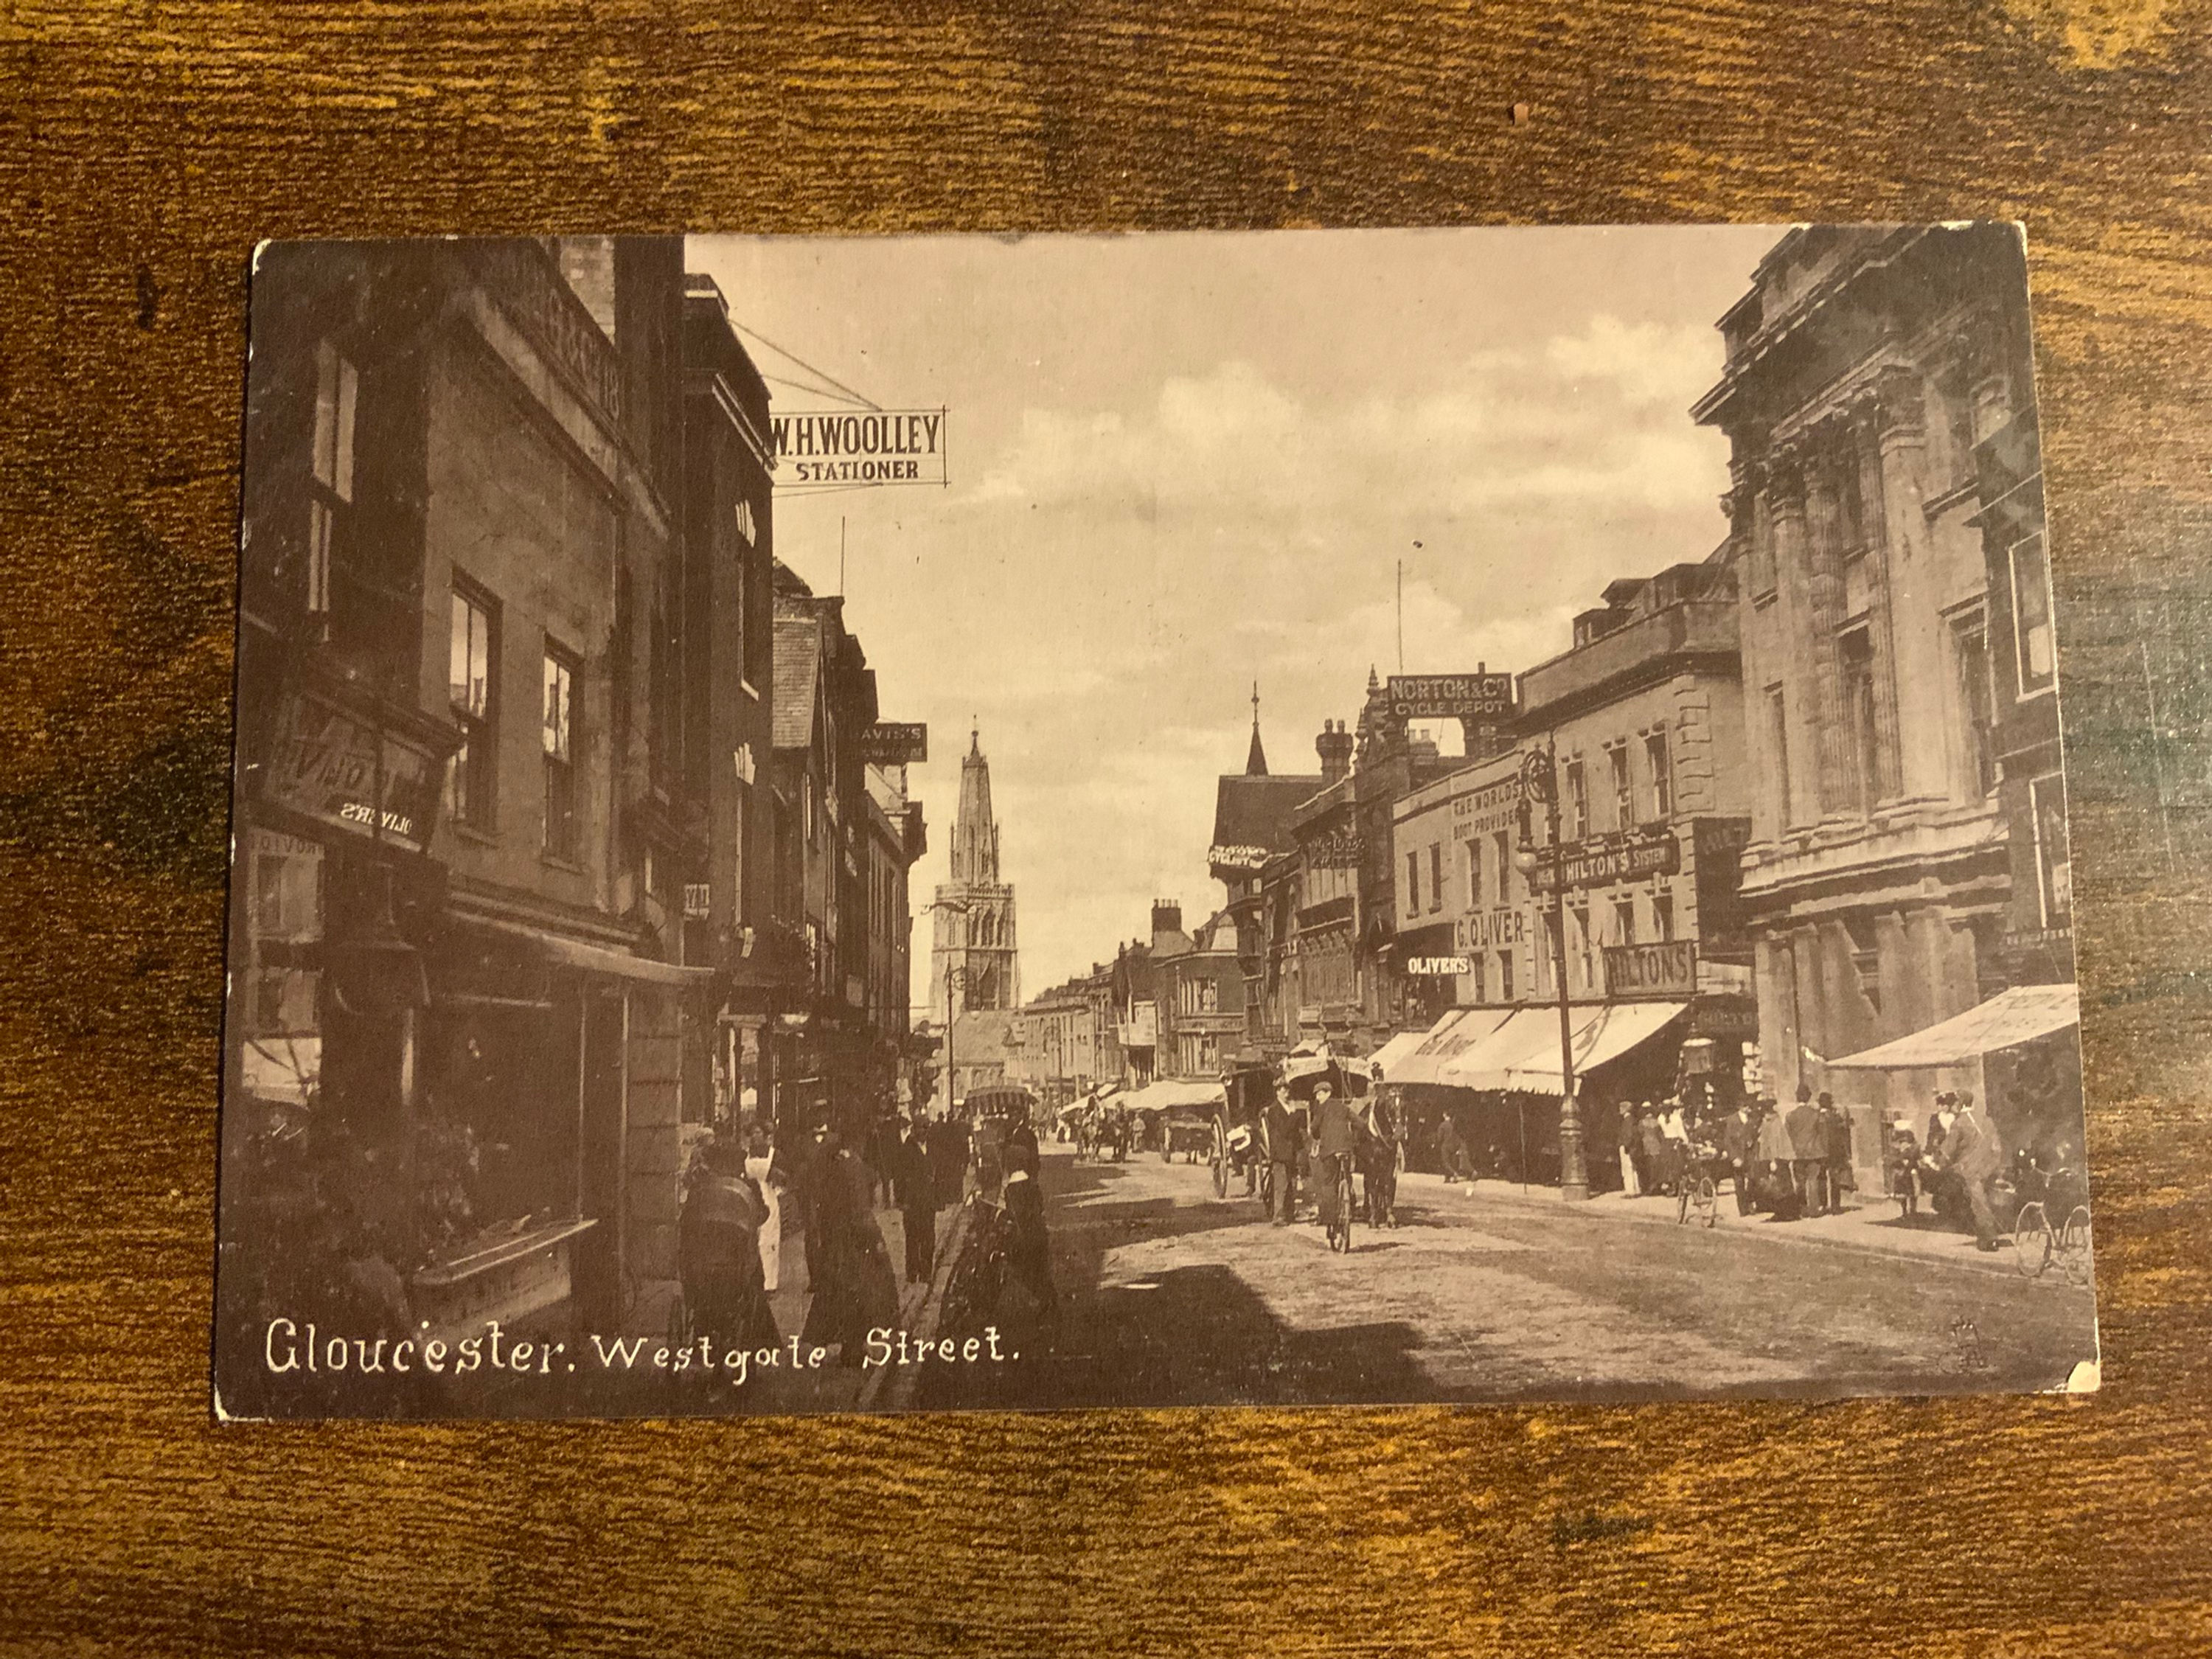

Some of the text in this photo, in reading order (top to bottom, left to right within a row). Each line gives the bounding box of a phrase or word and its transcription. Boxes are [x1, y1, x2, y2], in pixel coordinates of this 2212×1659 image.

[796, 460, 919, 481] STATIONER
[1394, 700, 1506, 716] CYCLE DEPOT
[1565, 851, 1630, 883] HILTON'S
[1632, 847, 1666, 868] SYSTEM
[1470, 911, 1523, 946] OLIVER
[266, 1318, 1020, 1385] Gloucester. Westgate Street.
